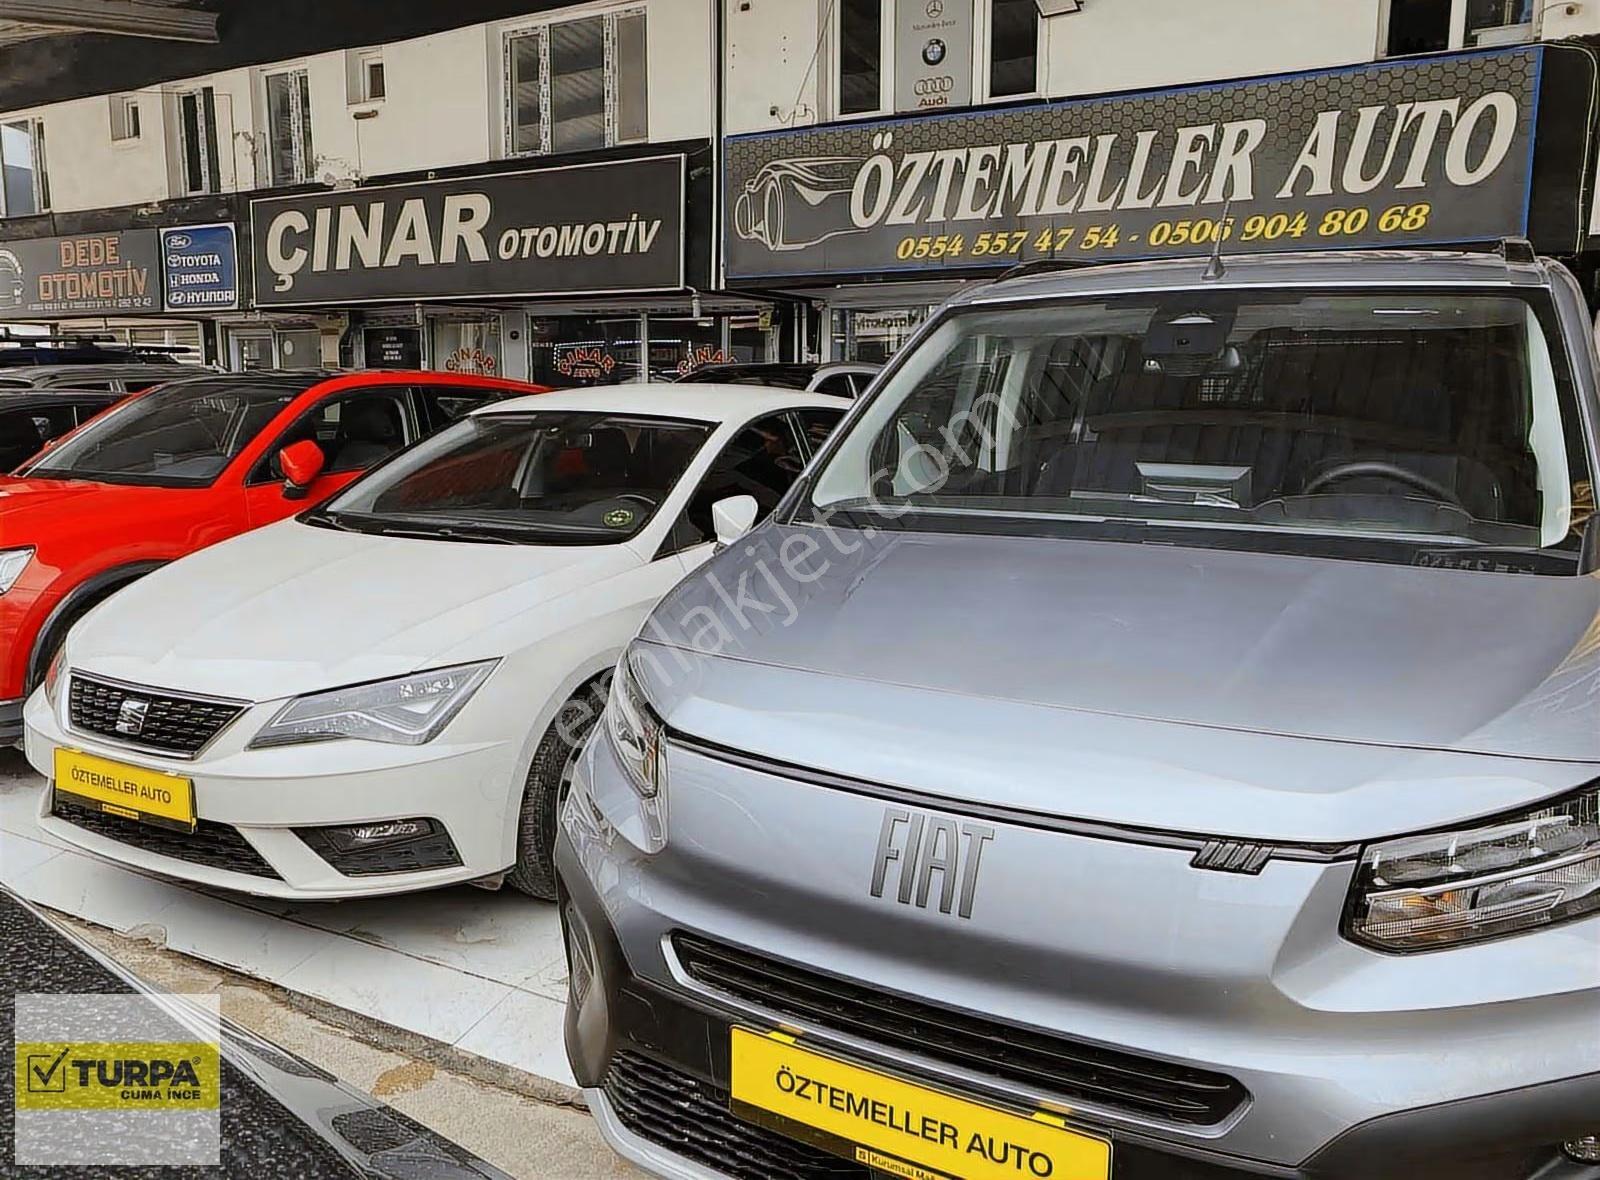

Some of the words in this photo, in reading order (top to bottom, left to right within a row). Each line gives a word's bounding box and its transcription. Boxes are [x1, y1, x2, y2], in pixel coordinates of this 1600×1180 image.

[849, 119, 1267, 230] ÖZTEMELLER
[1276, 92, 1518, 198] AUTO
[60, 236, 120, 268] DEDE
[266, 193, 491, 291] ÇINAR
[498, 213, 661, 261] OTOMOTİV
[897, 234, 963, 260] 0554
[970, 231, 1027, 255] 557
[1033, 228, 1075, 252] 47
[1079, 224, 1121, 250] 54
[1149, 218, 1231, 246] 0506
[1240, 211, 1307, 240] 904
[1319, 208, 1370, 236] 80
[1378, 204, 1431, 231] 68
[39, 260, 148, 300] OTOMOTİV
[181, 254, 222, 267] TOYOTA
[181, 273, 219, 285] HONDA
[187, 290, 235, 303] HYUNDAI
[71, 766, 138, 797] ÖZTEMELLER
[140, 786, 171, 804] AUTO
[870, 807, 995, 920] FIAT
[775, 1064, 958, 1149] ÖZTEMELLER
[966, 1133, 1053, 1178] AUTO
